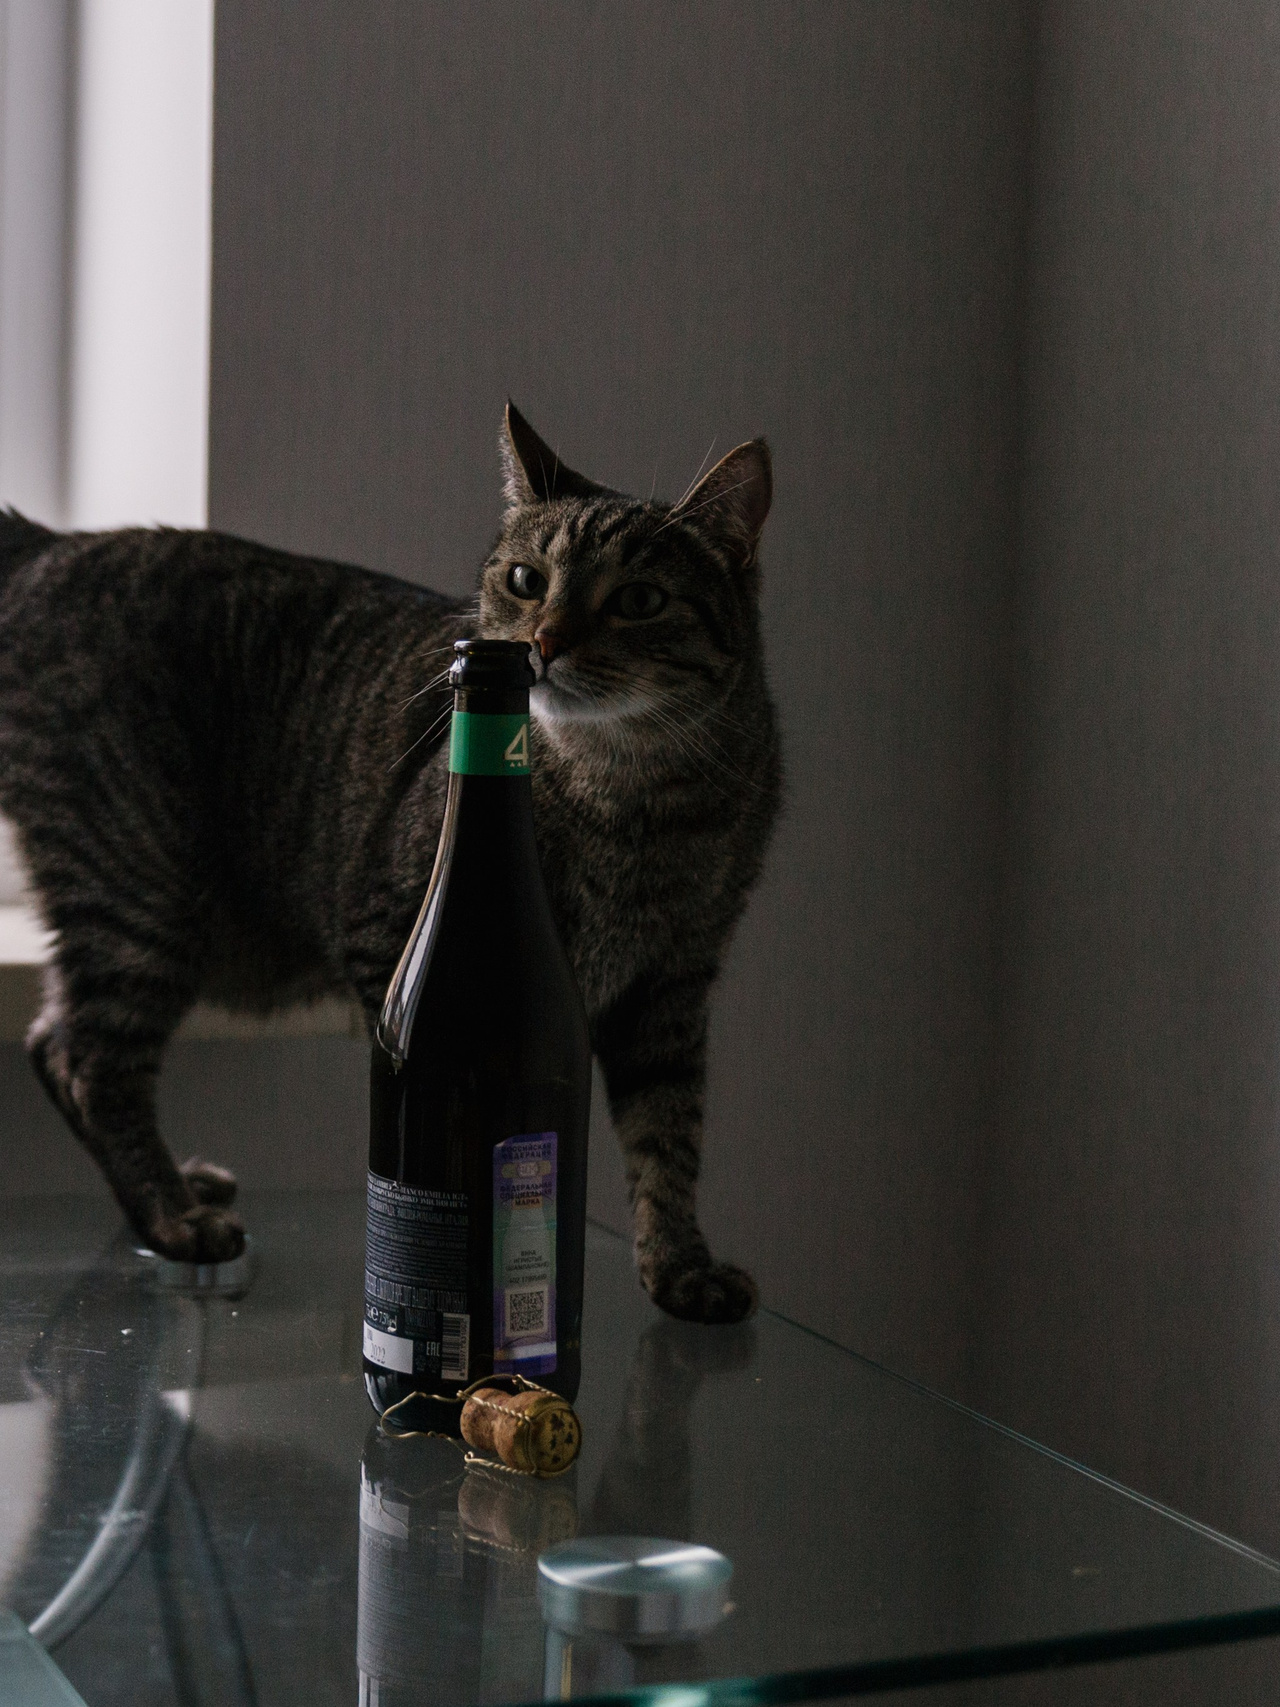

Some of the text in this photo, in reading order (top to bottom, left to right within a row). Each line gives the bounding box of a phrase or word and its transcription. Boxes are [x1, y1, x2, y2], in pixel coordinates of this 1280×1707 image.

[501, 1143, 551, 1153] РОССИЙСКАЯ
[500, 1181, 552, 1192] ФЕДЕРАЛЬНАЯ
[515, 1198, 540, 1206] МАРКА
